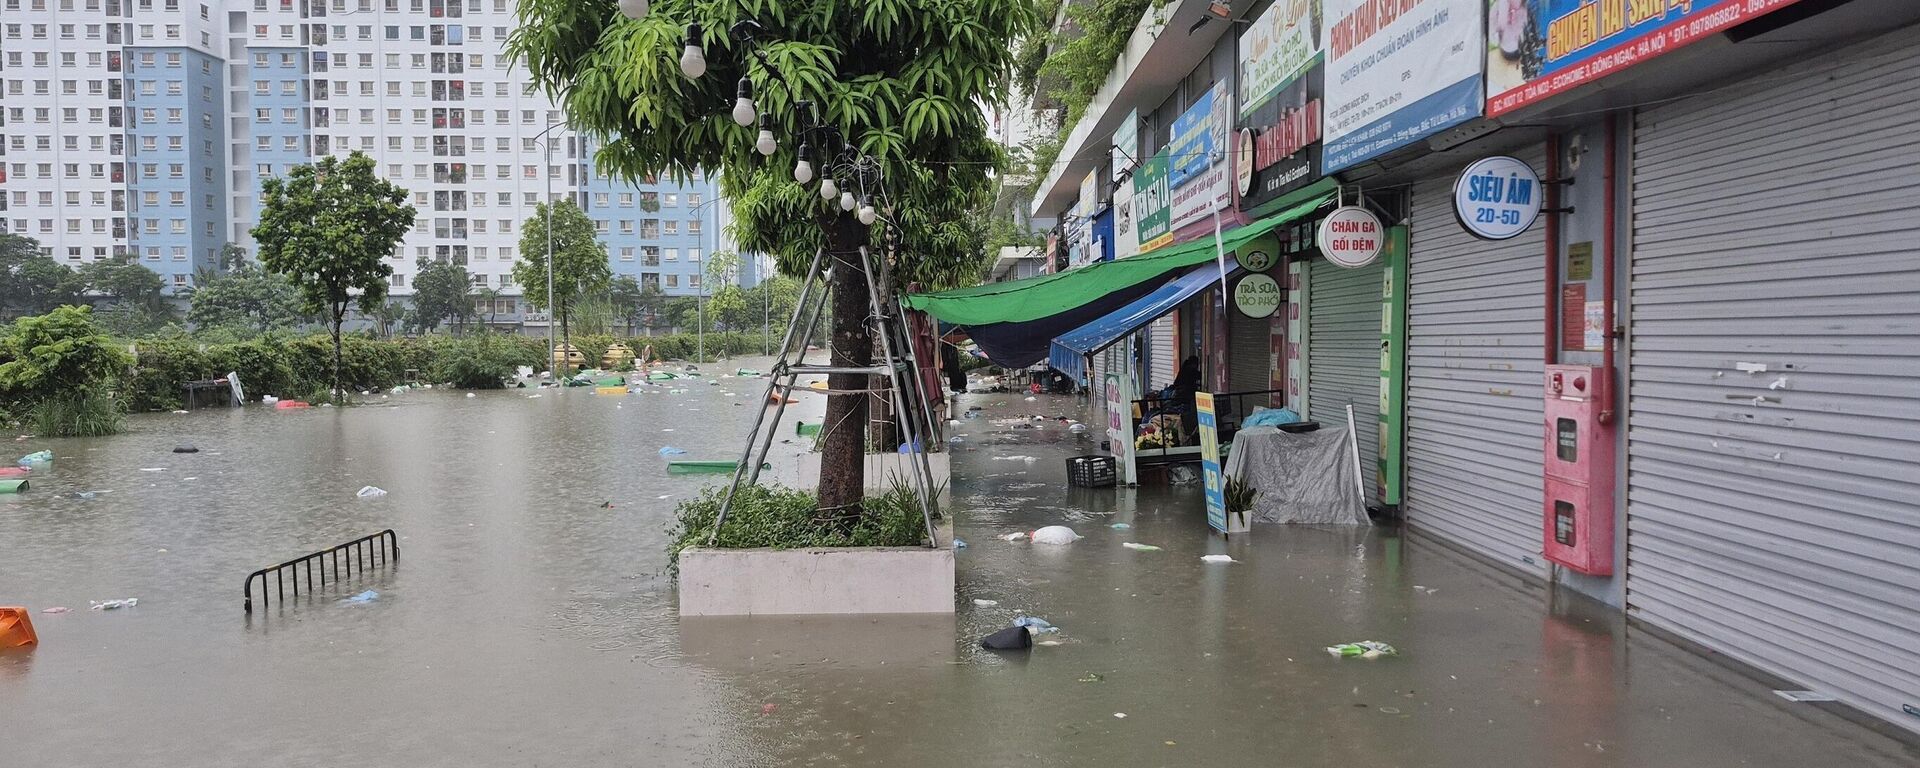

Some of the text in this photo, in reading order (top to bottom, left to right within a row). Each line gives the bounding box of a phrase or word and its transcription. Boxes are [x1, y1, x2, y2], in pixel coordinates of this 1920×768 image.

[1548, 1, 1597, 60] CHUYÊN
[1553, 66, 1584, 89] ECOHOME
[1592, 56, 1613, 75] ĐÔNG
[1613, 47, 1638, 67] NGẠC,
[1638, 39, 1650, 55] HÀ
[1651, 31, 1666, 52] NỘI
[1674, 26, 1689, 43] ĐT:
[1690, 3, 1740, 36] 0978068822
[1468, 170, 1532, 205] SIÊU ÂM
[1476, 208, 1520, 225] 2D-5D
[1362, 221, 1376, 233] GA
[1332, 235, 1375, 254] GỐI ĐỆM
[1240, 282, 1278, 294] TRÀ SỮA
